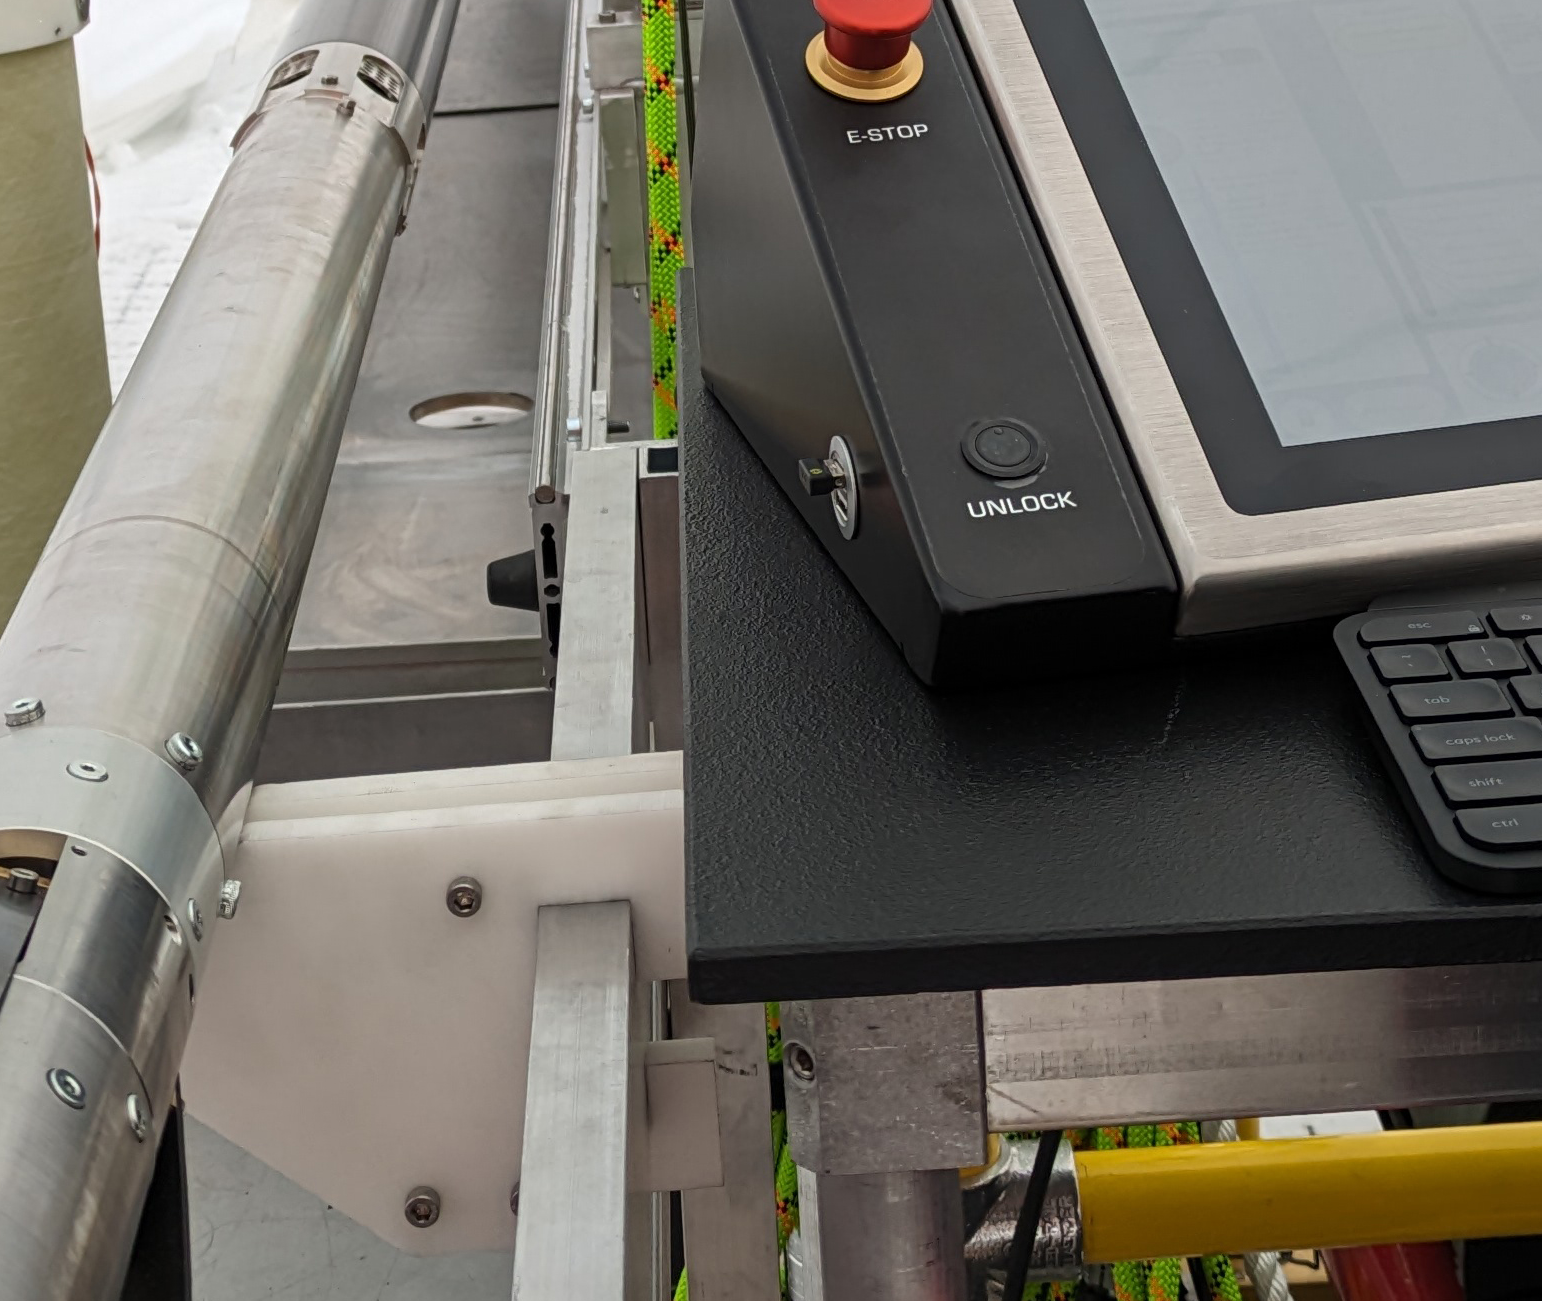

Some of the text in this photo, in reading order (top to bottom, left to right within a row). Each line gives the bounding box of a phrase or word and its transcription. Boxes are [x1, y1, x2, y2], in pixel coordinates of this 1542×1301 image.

[846, 122, 930, 145] E-STOP
[966, 491, 1078, 519] UNLOCK
[1407, 621, 1432, 630] esc
[1423, 695, 1451, 706] tab
[1444, 732, 1517, 747] caps lock
[1467, 776, 1504, 788] shift
[1490, 817, 1520, 829] ctrl
